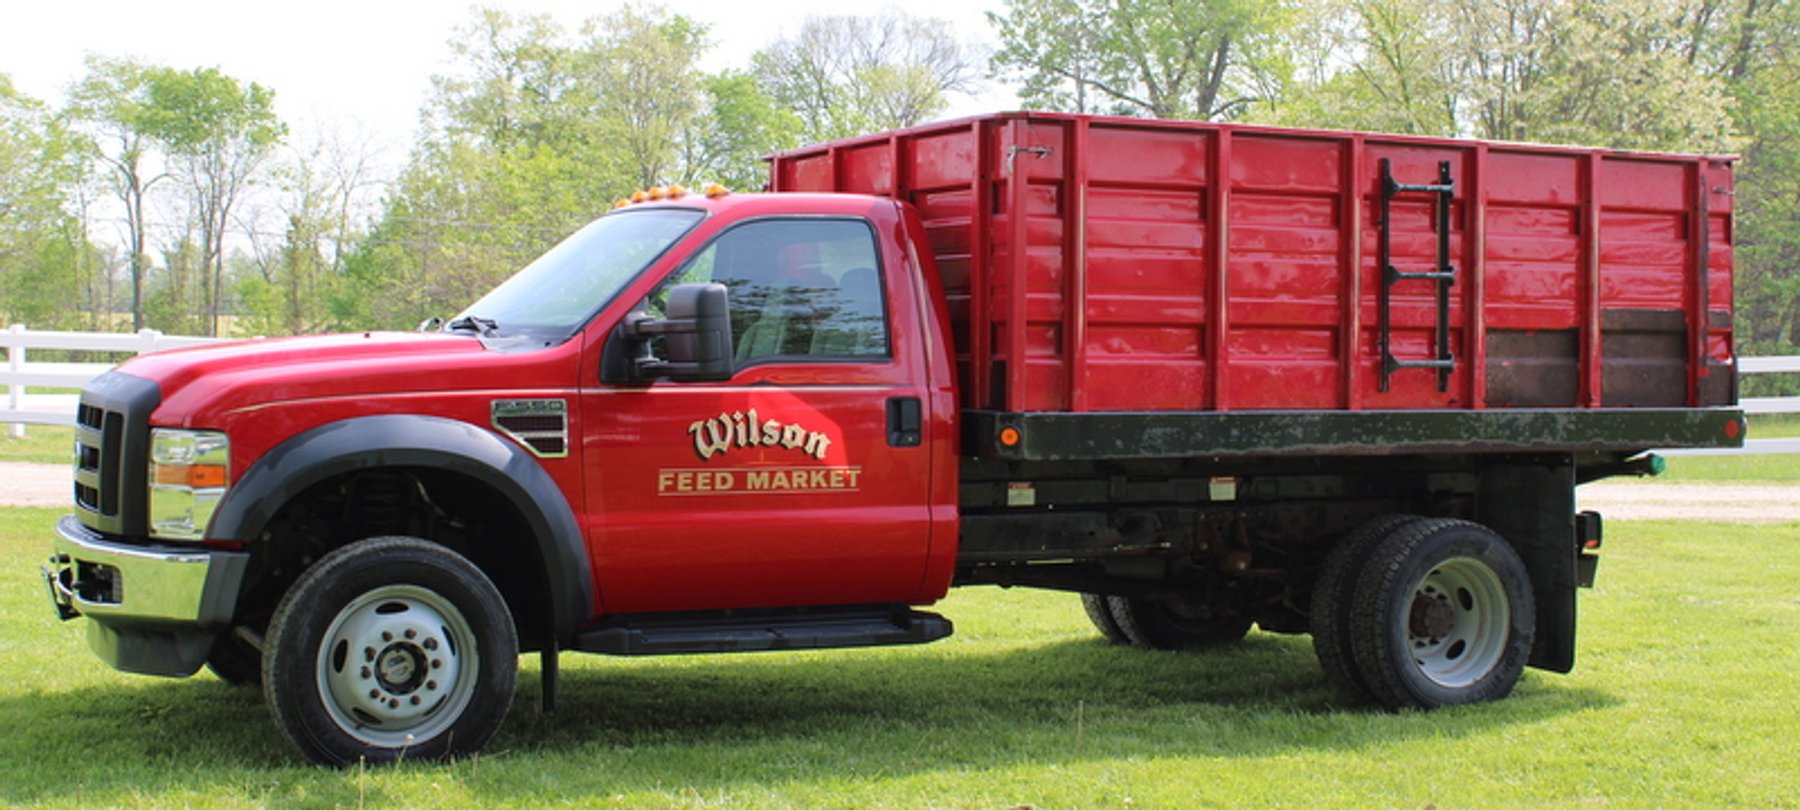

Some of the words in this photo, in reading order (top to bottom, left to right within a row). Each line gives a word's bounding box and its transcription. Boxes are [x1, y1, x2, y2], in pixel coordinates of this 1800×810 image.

[689, 408, 832, 461] Wilson
[658, 472, 735, 491] FEED
[746, 470, 862, 489] MARKET
